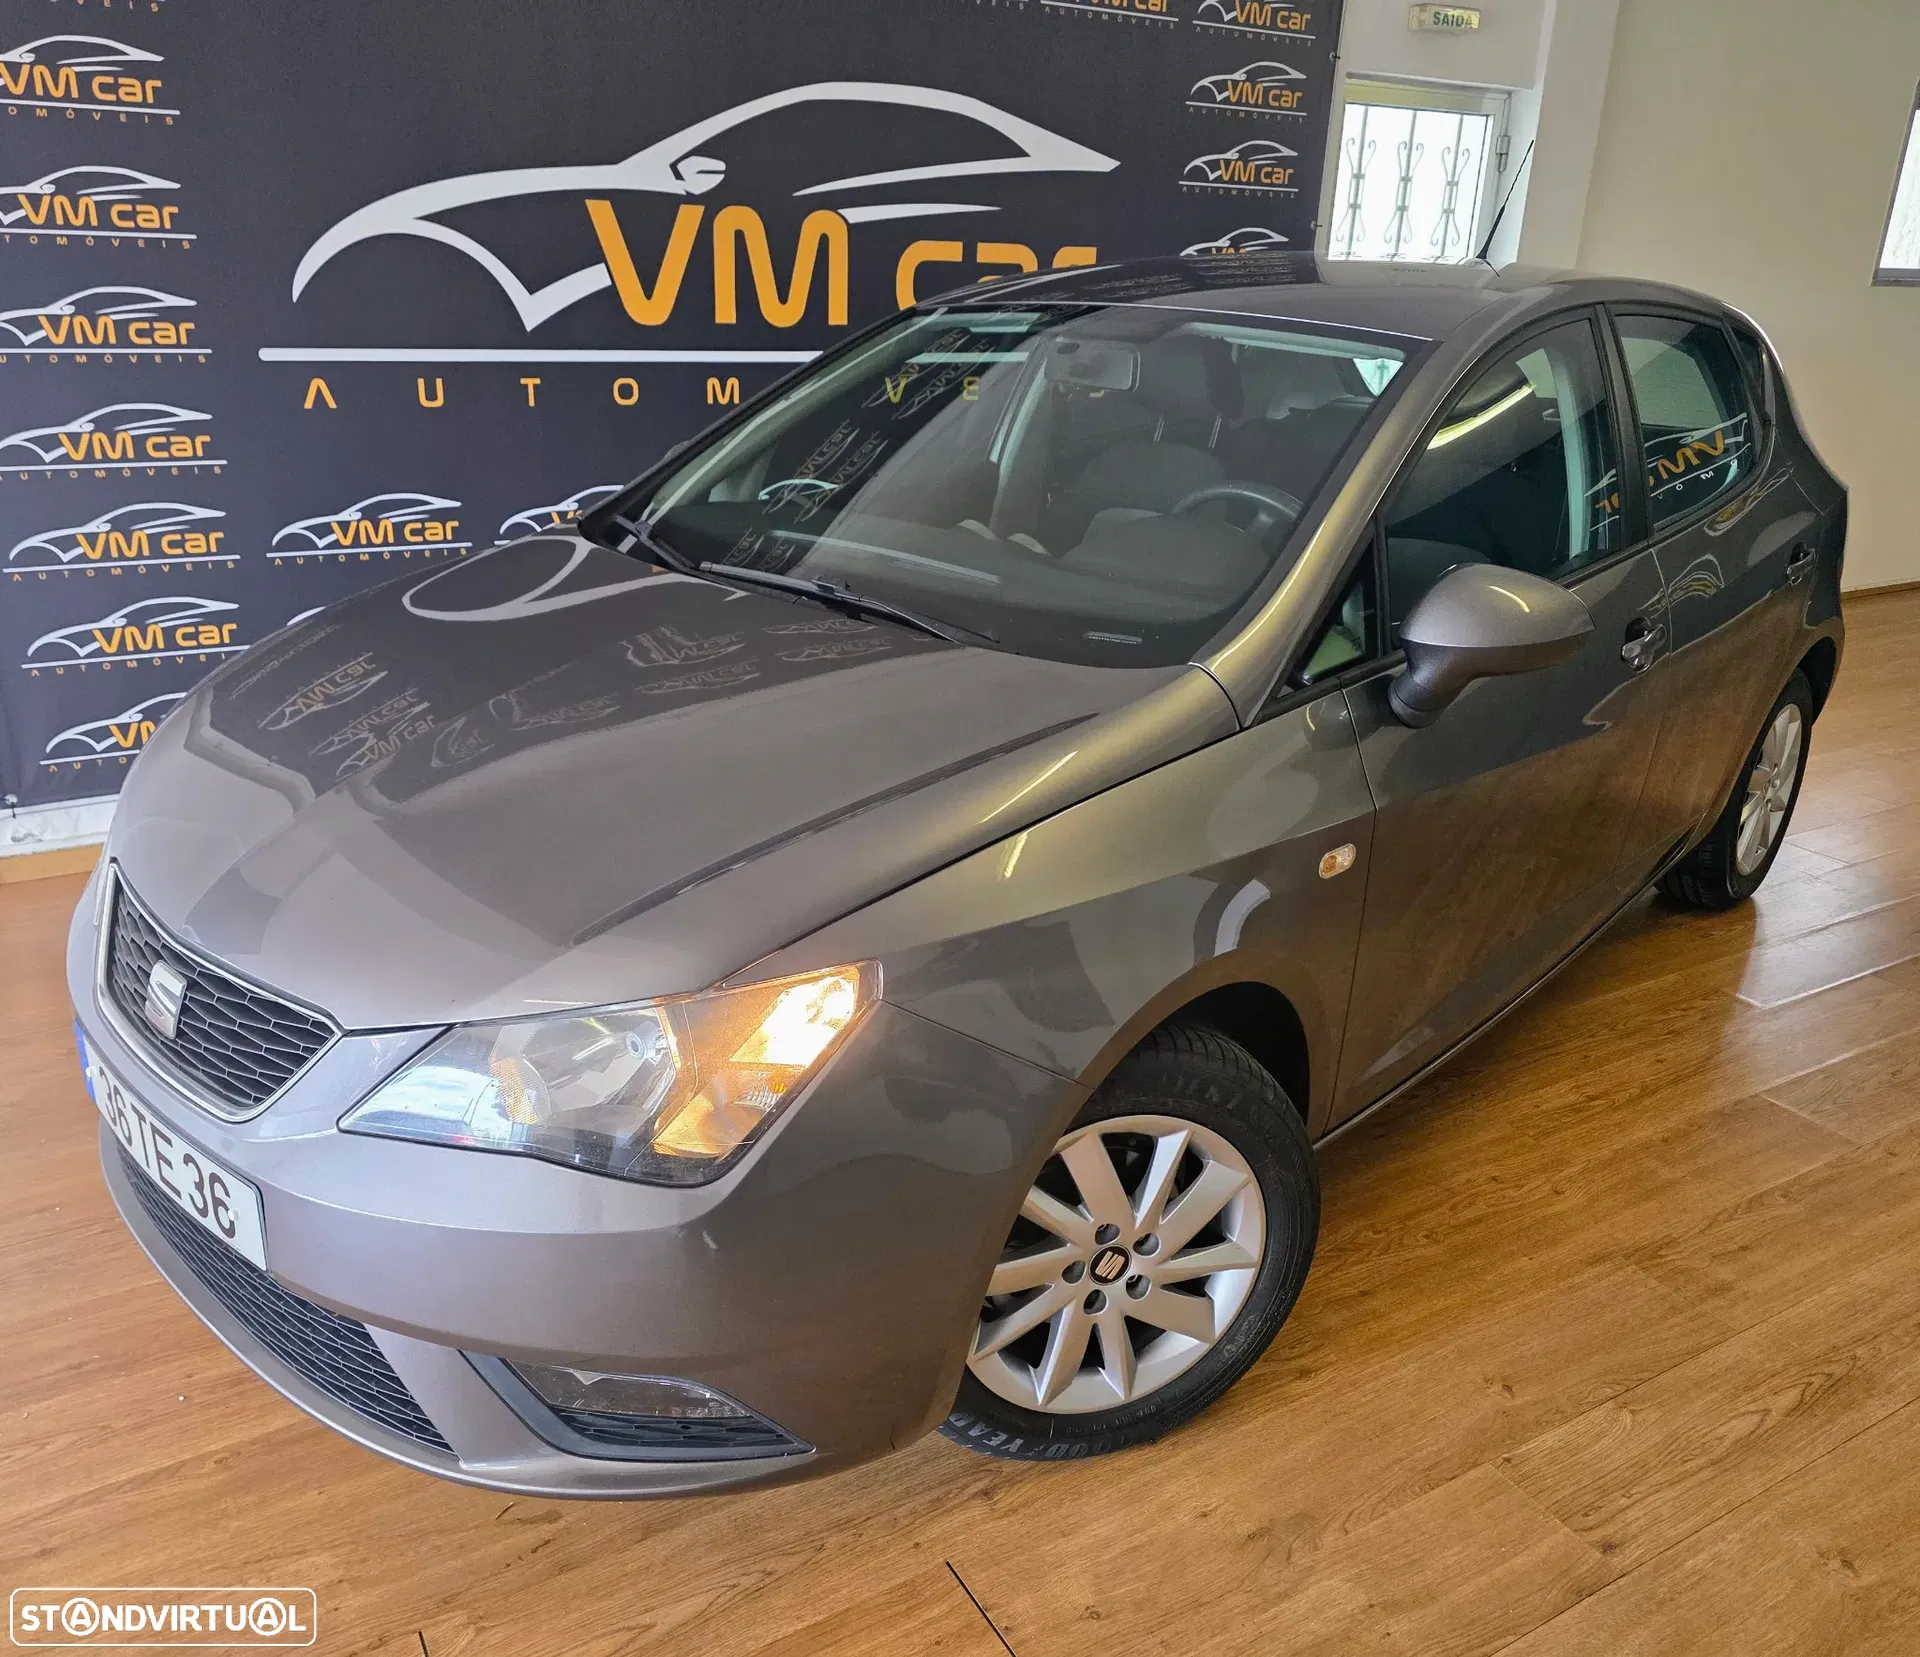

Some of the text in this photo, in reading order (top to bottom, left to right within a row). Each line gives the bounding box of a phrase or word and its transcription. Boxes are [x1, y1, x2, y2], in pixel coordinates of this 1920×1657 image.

[1234, 0, 1311, 31] VM car
[0, 63, 162, 104] VM car
[1227, 80, 1303, 108] VM car
[7, 106, 174, 126] OMÓVEIS
[1219, 159, 1294, 185] VM car
[17, 193, 179, 230] VM car
[4, 235, 190, 250] TOMÓVEIS
[584, 199, 849, 328] VM
[38, 314, 195, 345] VM car
[0, 354, 206, 364] UTOMÓVEIS
[57, 431, 211, 461] VM car
[0, 465, 222, 481] UTOMÓVEIS
[76, 530, 224, 560] VM car
[331, 518, 460, 547] VM car
[12, 561, 235, 582] AUTOMÓVEIS
[92, 622, 238, 654] VM car
[31, 653, 227, 677] AUTOMÓVEI
